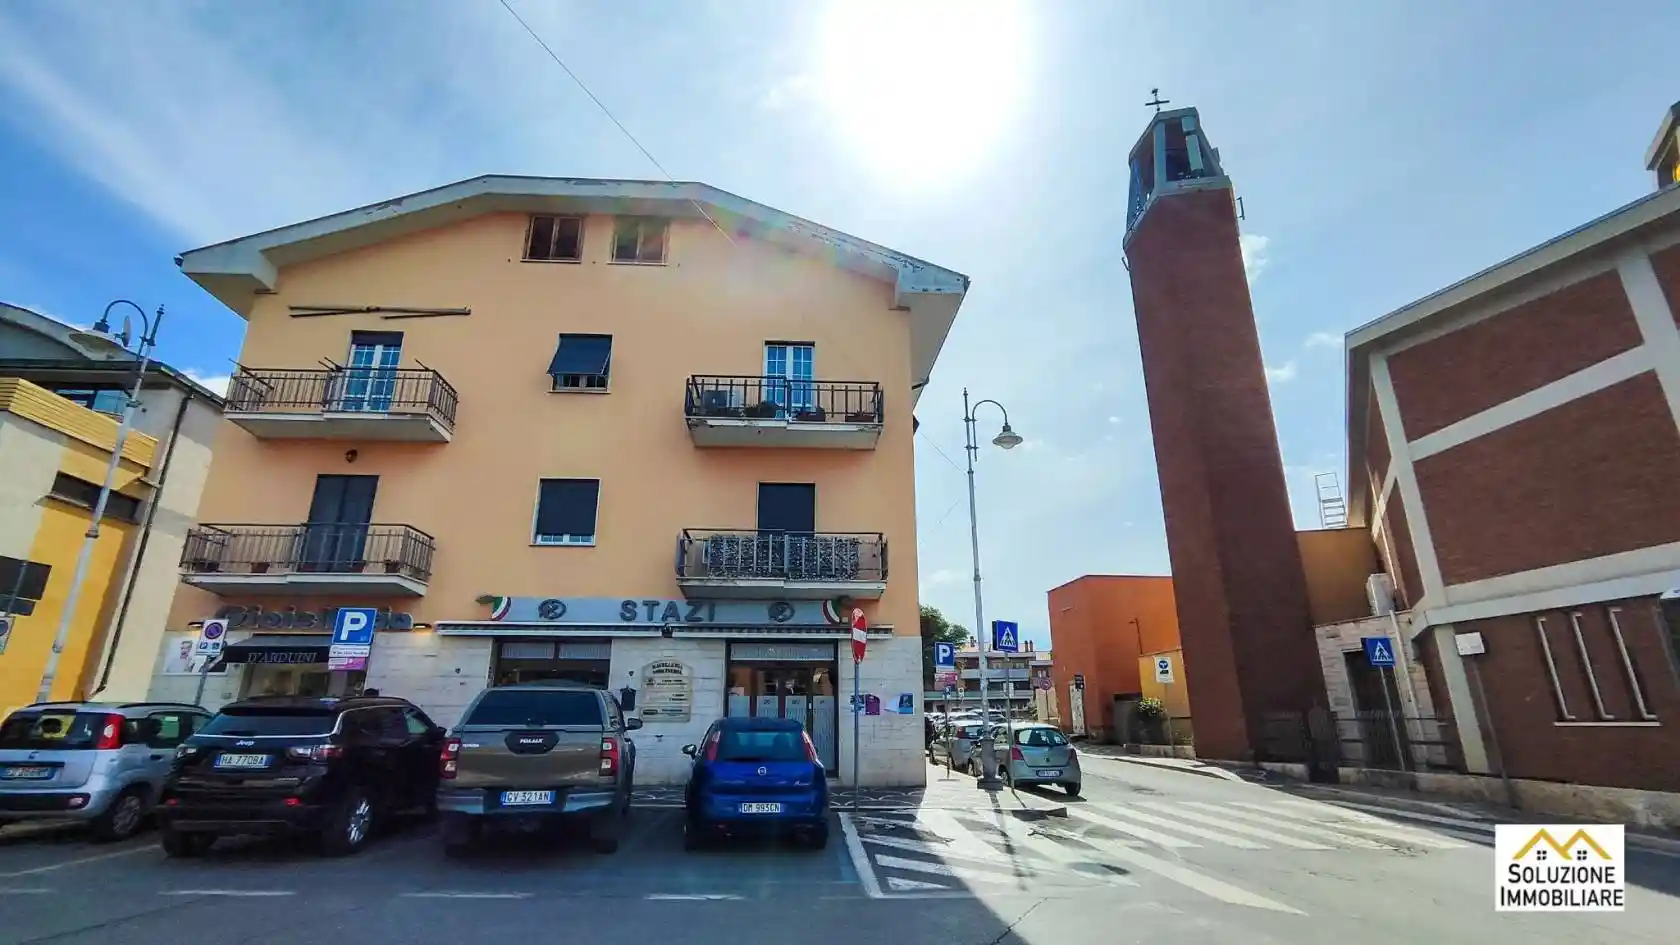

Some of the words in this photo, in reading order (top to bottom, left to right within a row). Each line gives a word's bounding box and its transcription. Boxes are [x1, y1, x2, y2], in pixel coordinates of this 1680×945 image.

[620, 600, 715, 622] STAZI
[340, 611, 368, 641] P
[938, 644, 951, 664] P
